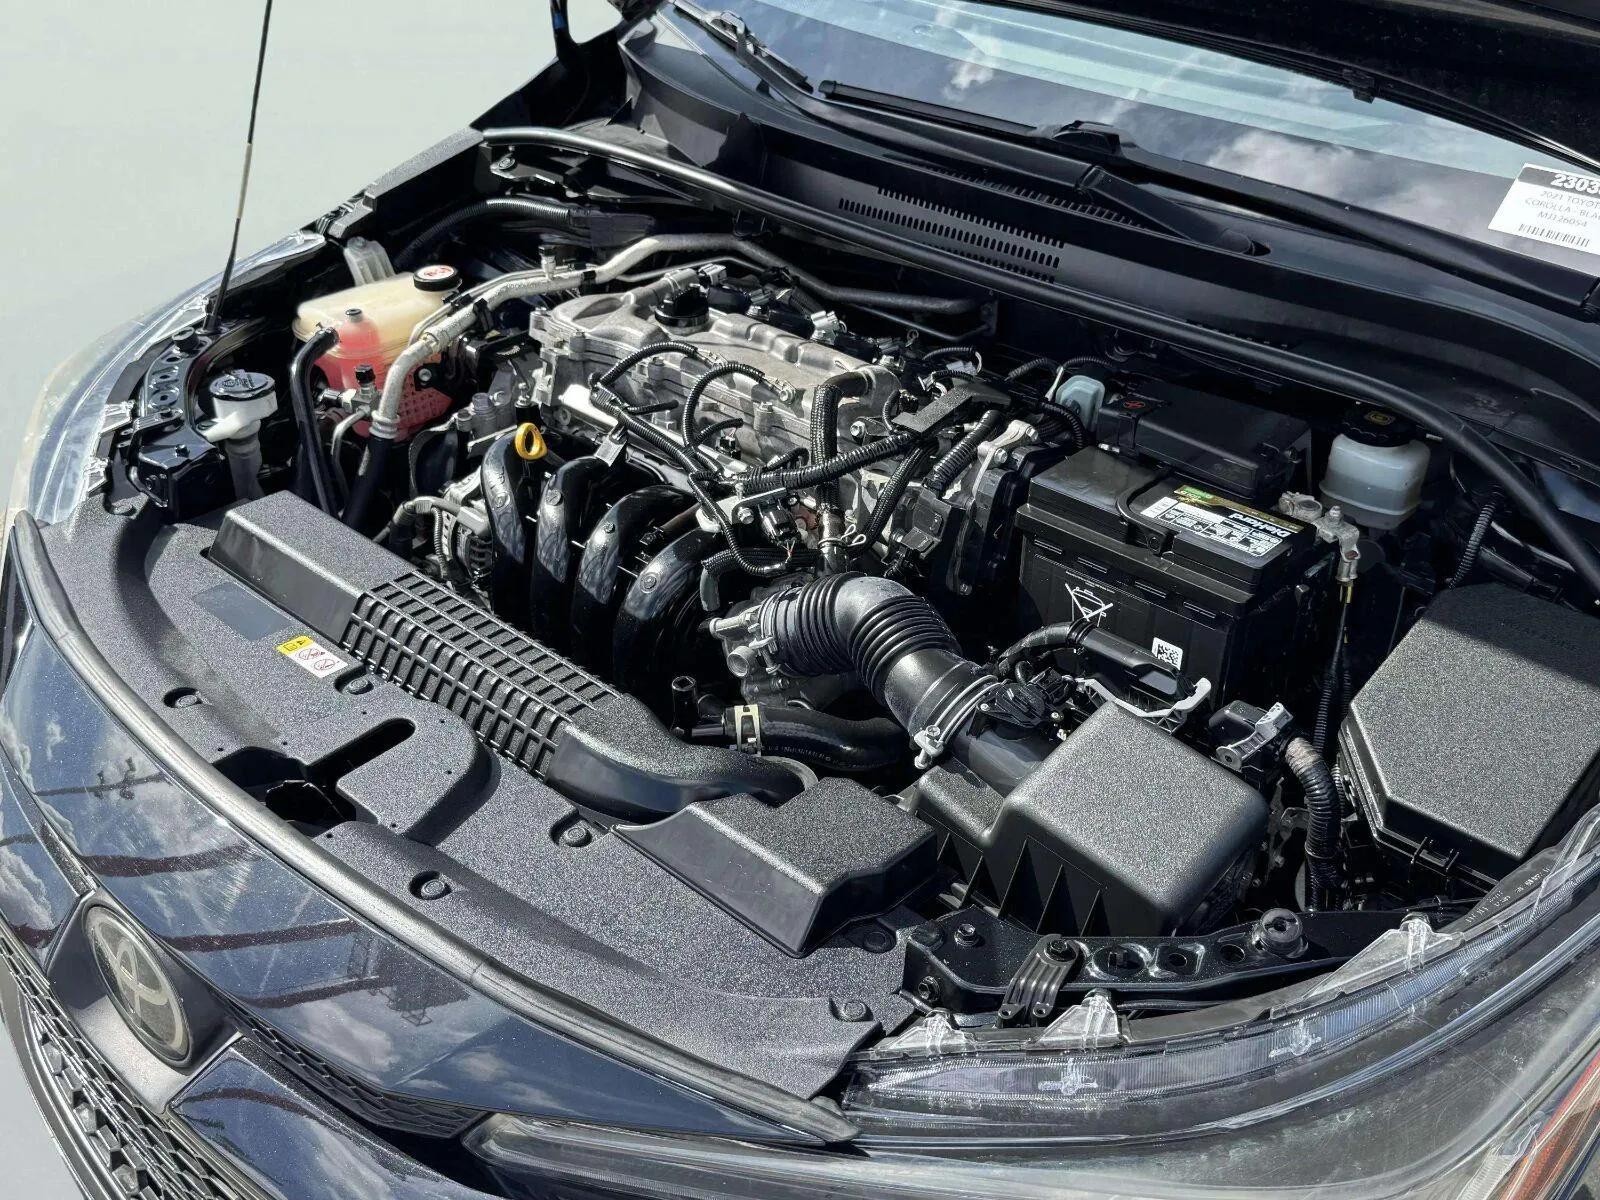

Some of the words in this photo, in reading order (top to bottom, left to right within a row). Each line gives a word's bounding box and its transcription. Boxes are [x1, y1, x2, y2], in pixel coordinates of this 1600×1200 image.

[1541, 190, 1563, 201] 2021
[1550, 174, 1600, 195] 2303
[1525, 197, 1571, 212] COROLLA
[1580, 209, 1600, 220] BLA
[1228, 513, 1292, 538] DieHard
